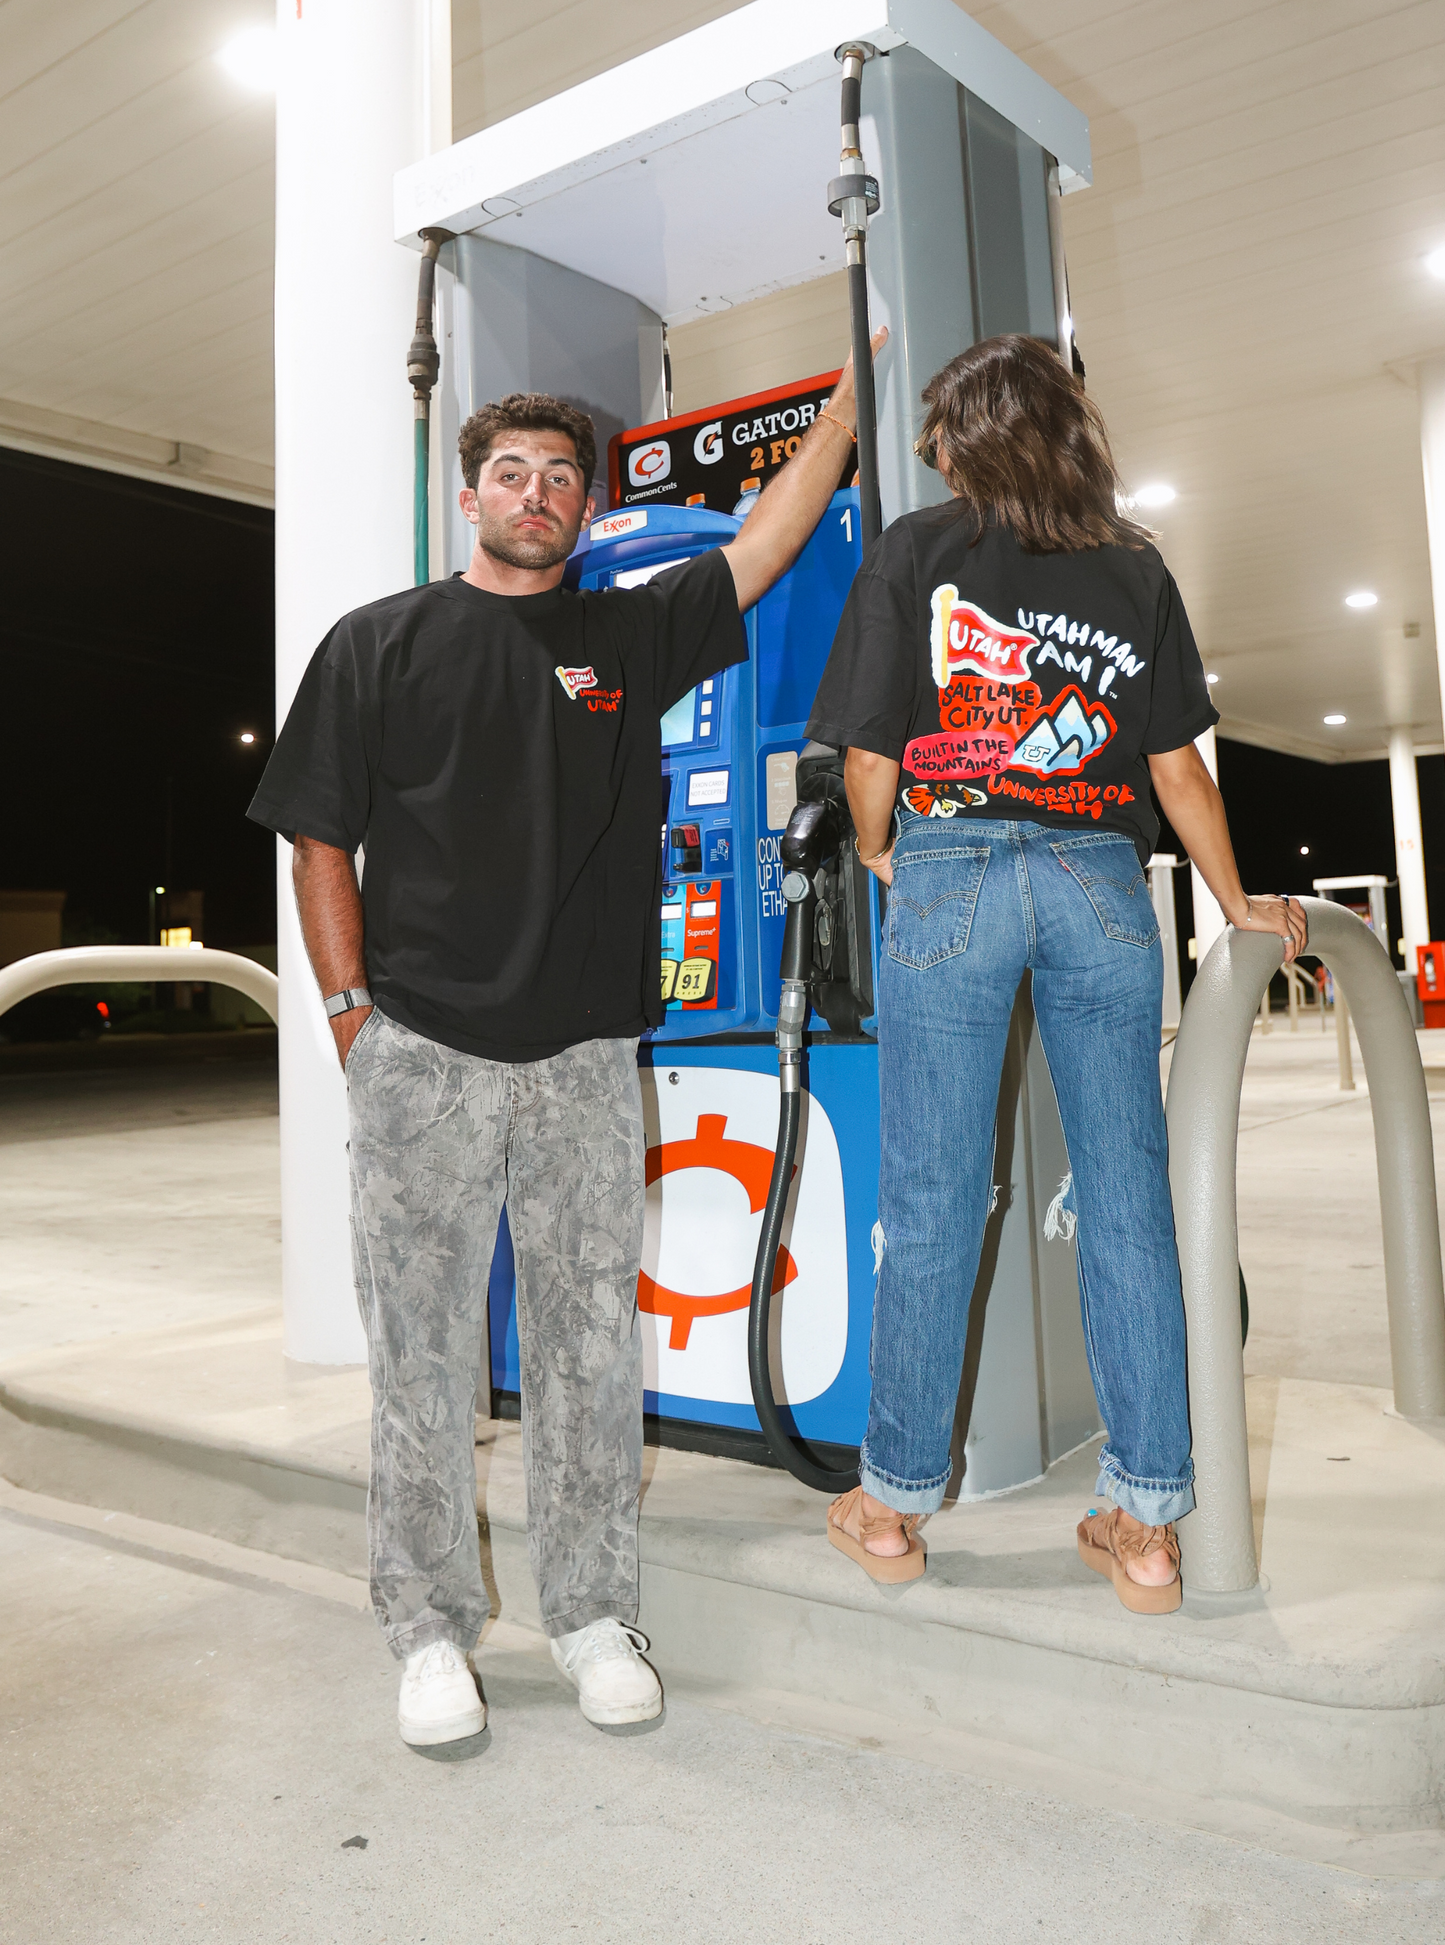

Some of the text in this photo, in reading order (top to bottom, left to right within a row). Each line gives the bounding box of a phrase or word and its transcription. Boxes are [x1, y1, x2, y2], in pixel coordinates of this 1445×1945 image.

[732, 397, 829, 446] GATOR
[750, 447, 765, 471] 2
[603, 517, 632, 533] Exxon
[840, 509, 852, 542] 1
[1017, 607, 1146, 678] UTAH MAN
[1035, 640, 1093, 683] AM
[566, 673, 591, 686] UTAH
[942, 682, 1035, 707] SALT LAKE
[948, 706, 994, 730] CITY
[912, 738, 1009, 762] BUILT IN THE
[914, 757, 1001, 773] MOUNTAINS
[987, 773, 1101, 806] UNIVERSITY
[758, 836, 783, 864] CON
[758, 863, 773, 891] UP
[682, 974, 701, 989] 91
